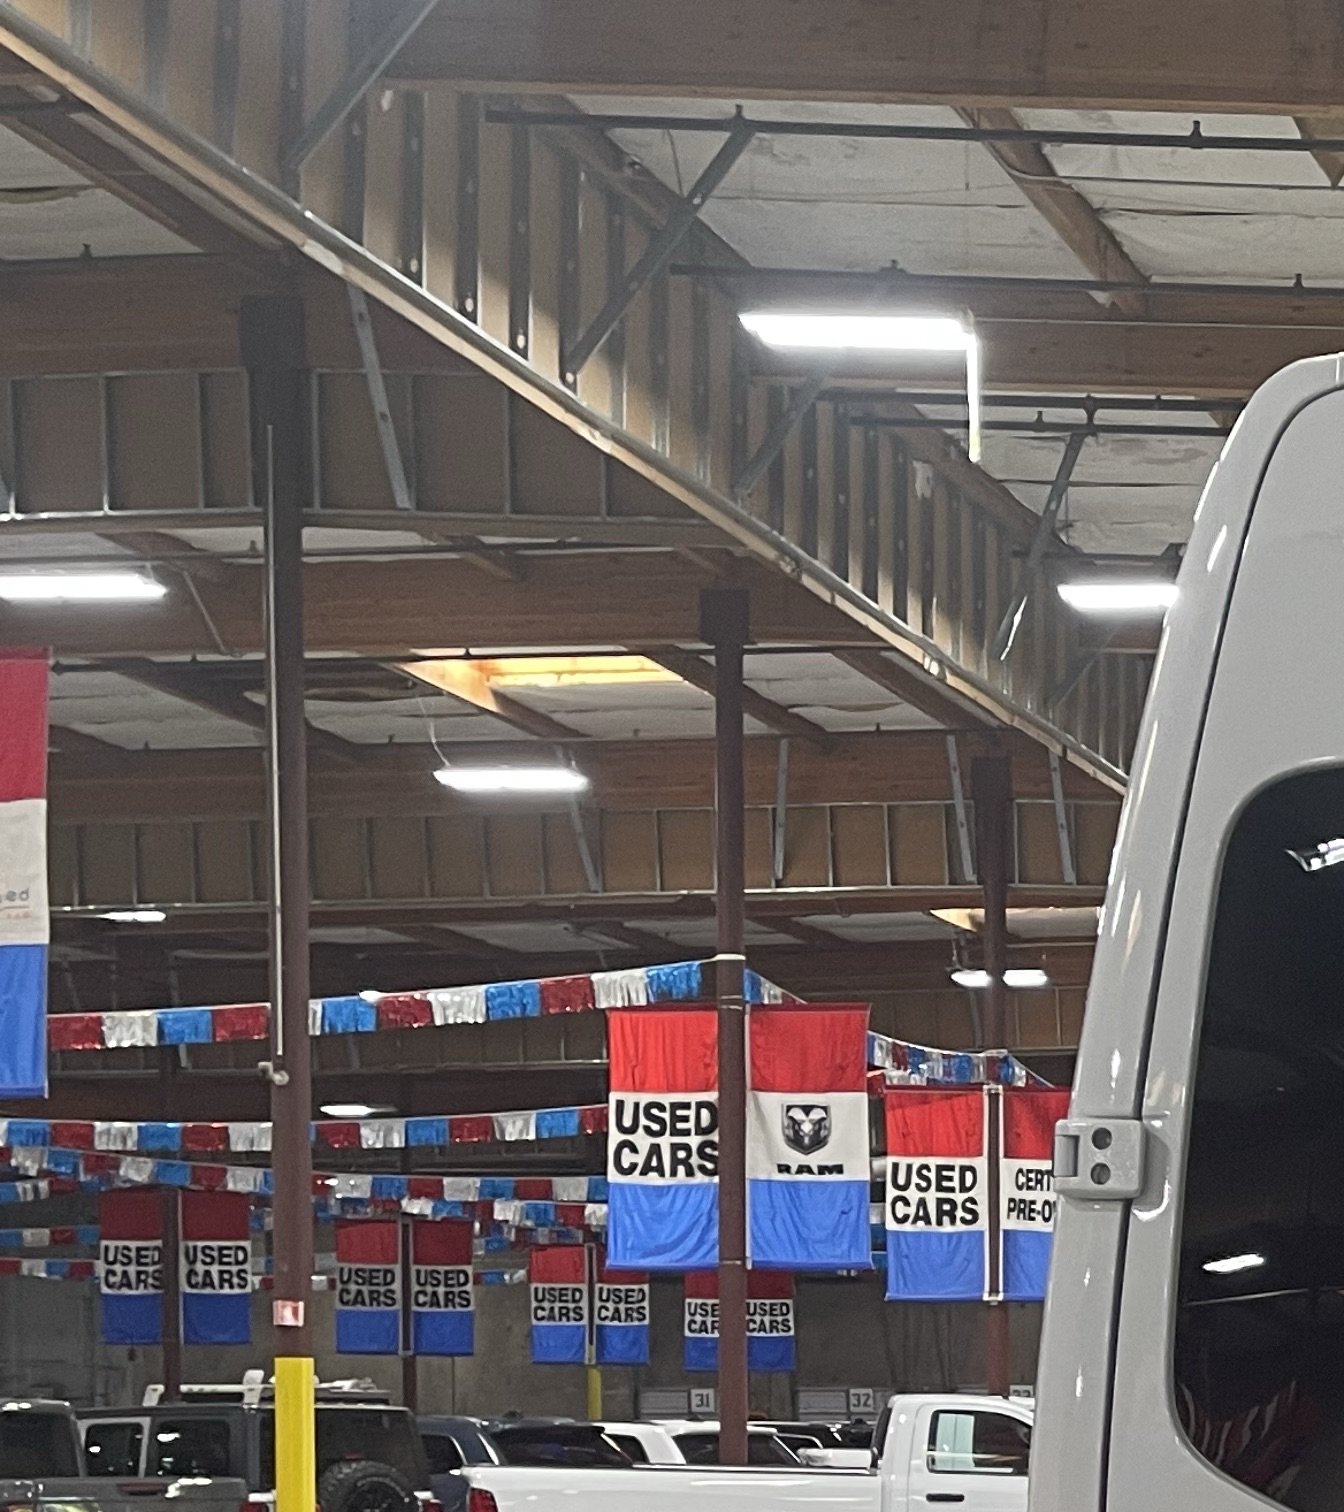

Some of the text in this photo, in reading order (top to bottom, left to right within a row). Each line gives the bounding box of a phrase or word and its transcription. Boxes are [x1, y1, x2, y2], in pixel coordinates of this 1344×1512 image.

[615, 1099, 719, 1138] USED
[613, 1138, 719, 1178] CARS
[776, 1163, 844, 1176] RAM
[891, 1161, 978, 1194] USED
[1014, 1167, 1054, 1192] CERT
[890, 1194, 980, 1227] CARS
[1006, 1197, 1057, 1223] PRE-O
[103, 1244, 161, 1267] USED
[184, 1245, 249, 1267] USED
[104, 1267, 163, 1291] CARS
[185, 1267, 249, 1290] CARS
[339, 1266, 396, 1287] USED
[415, 1268, 470, 1288] USED
[338, 1287, 397, 1307] CARS
[413, 1289, 472, 1309] CARS
[533, 1286, 584, 1304] USED
[599, 1286, 646, 1305] USED
[533, 1305, 584, 1323] CARS
[597, 1304, 647, 1323] CARS
[687, 1302, 720, 1318] USE
[746, 1302, 790, 1317] USED
[687, 1318, 720, 1335] CAR
[746, 1318, 792, 1334] CARS
[694, 1393, 710, 1408] 31
[851, 1393, 872, 1408] 32
